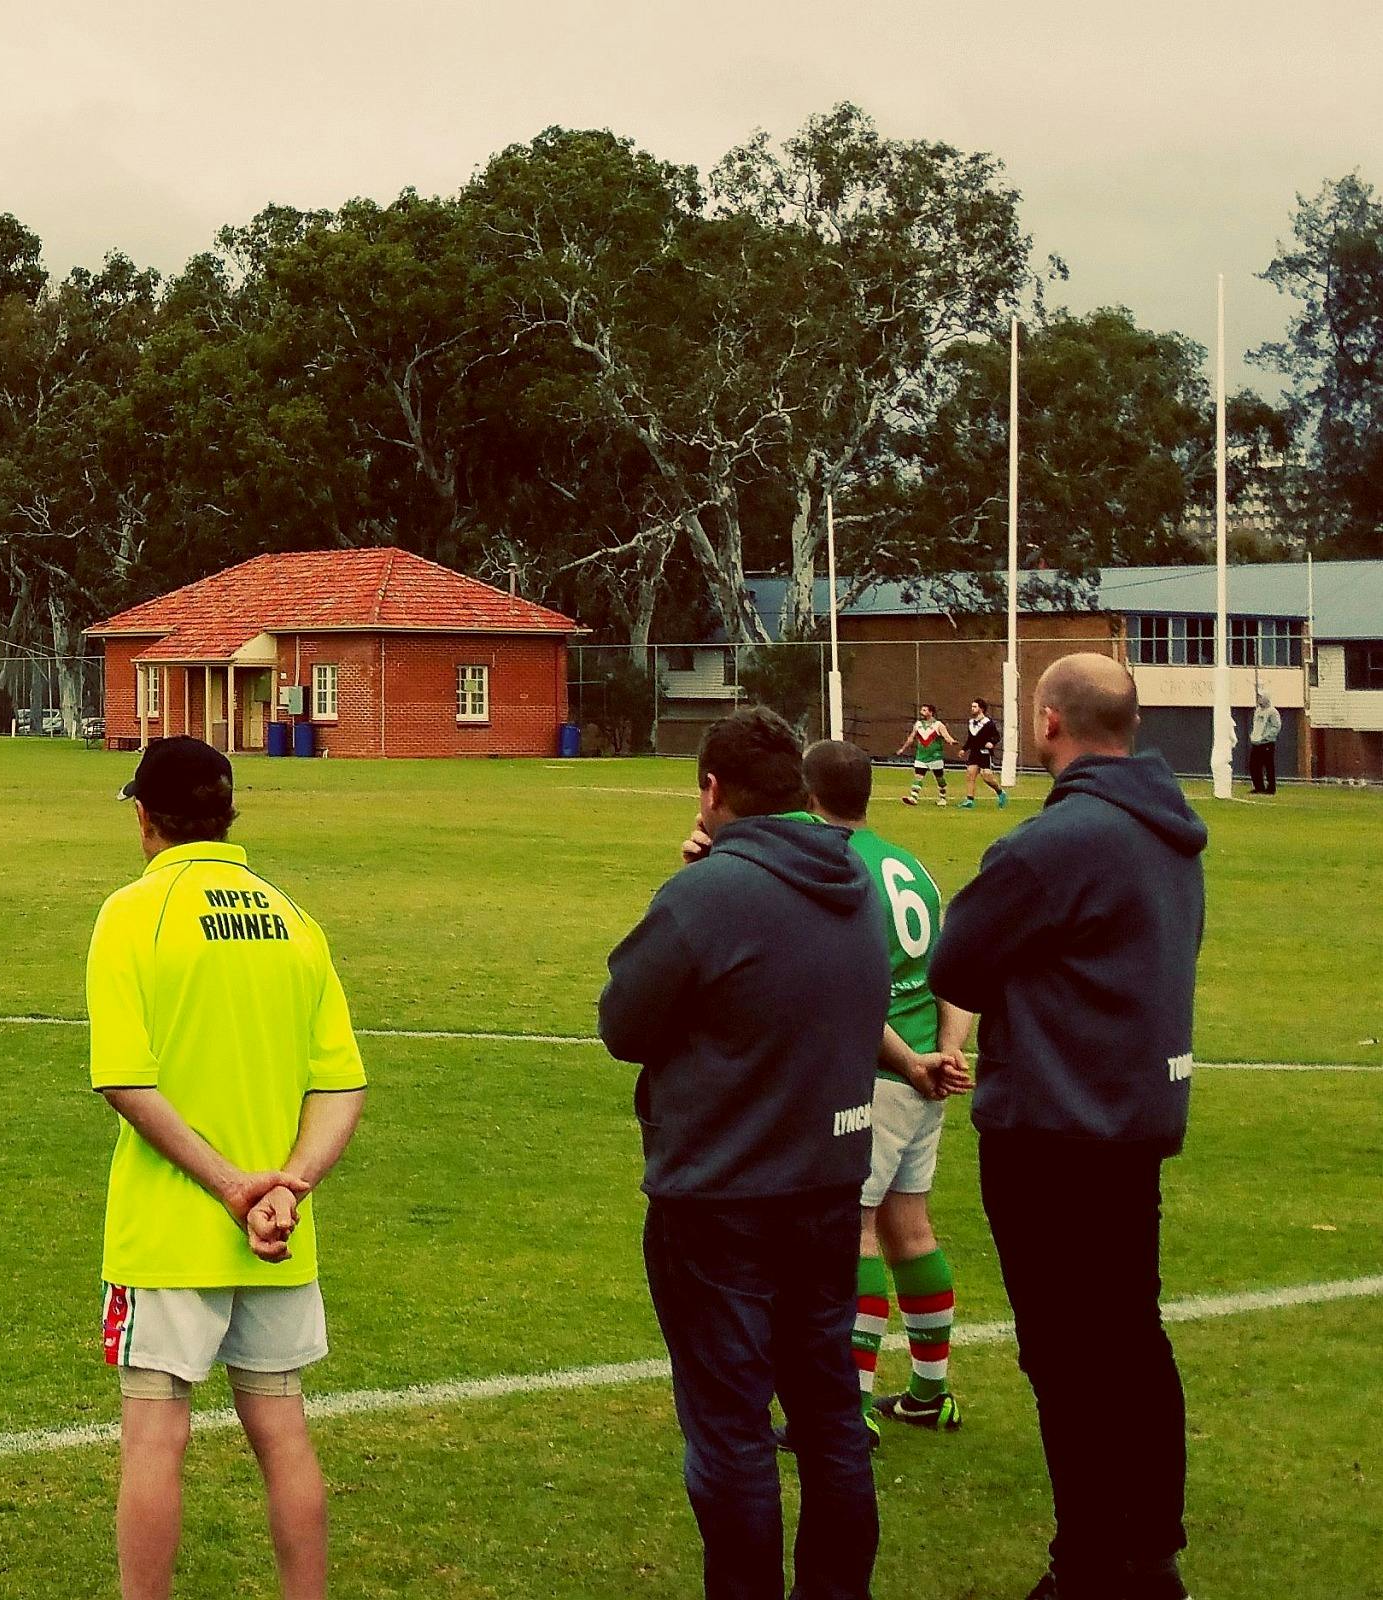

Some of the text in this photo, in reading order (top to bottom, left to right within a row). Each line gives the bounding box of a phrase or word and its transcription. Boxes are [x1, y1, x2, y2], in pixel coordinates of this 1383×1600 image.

[204, 889, 269, 909] MPFC
[881, 857, 931, 958] 6
[199, 913, 289, 940] RUNNER
